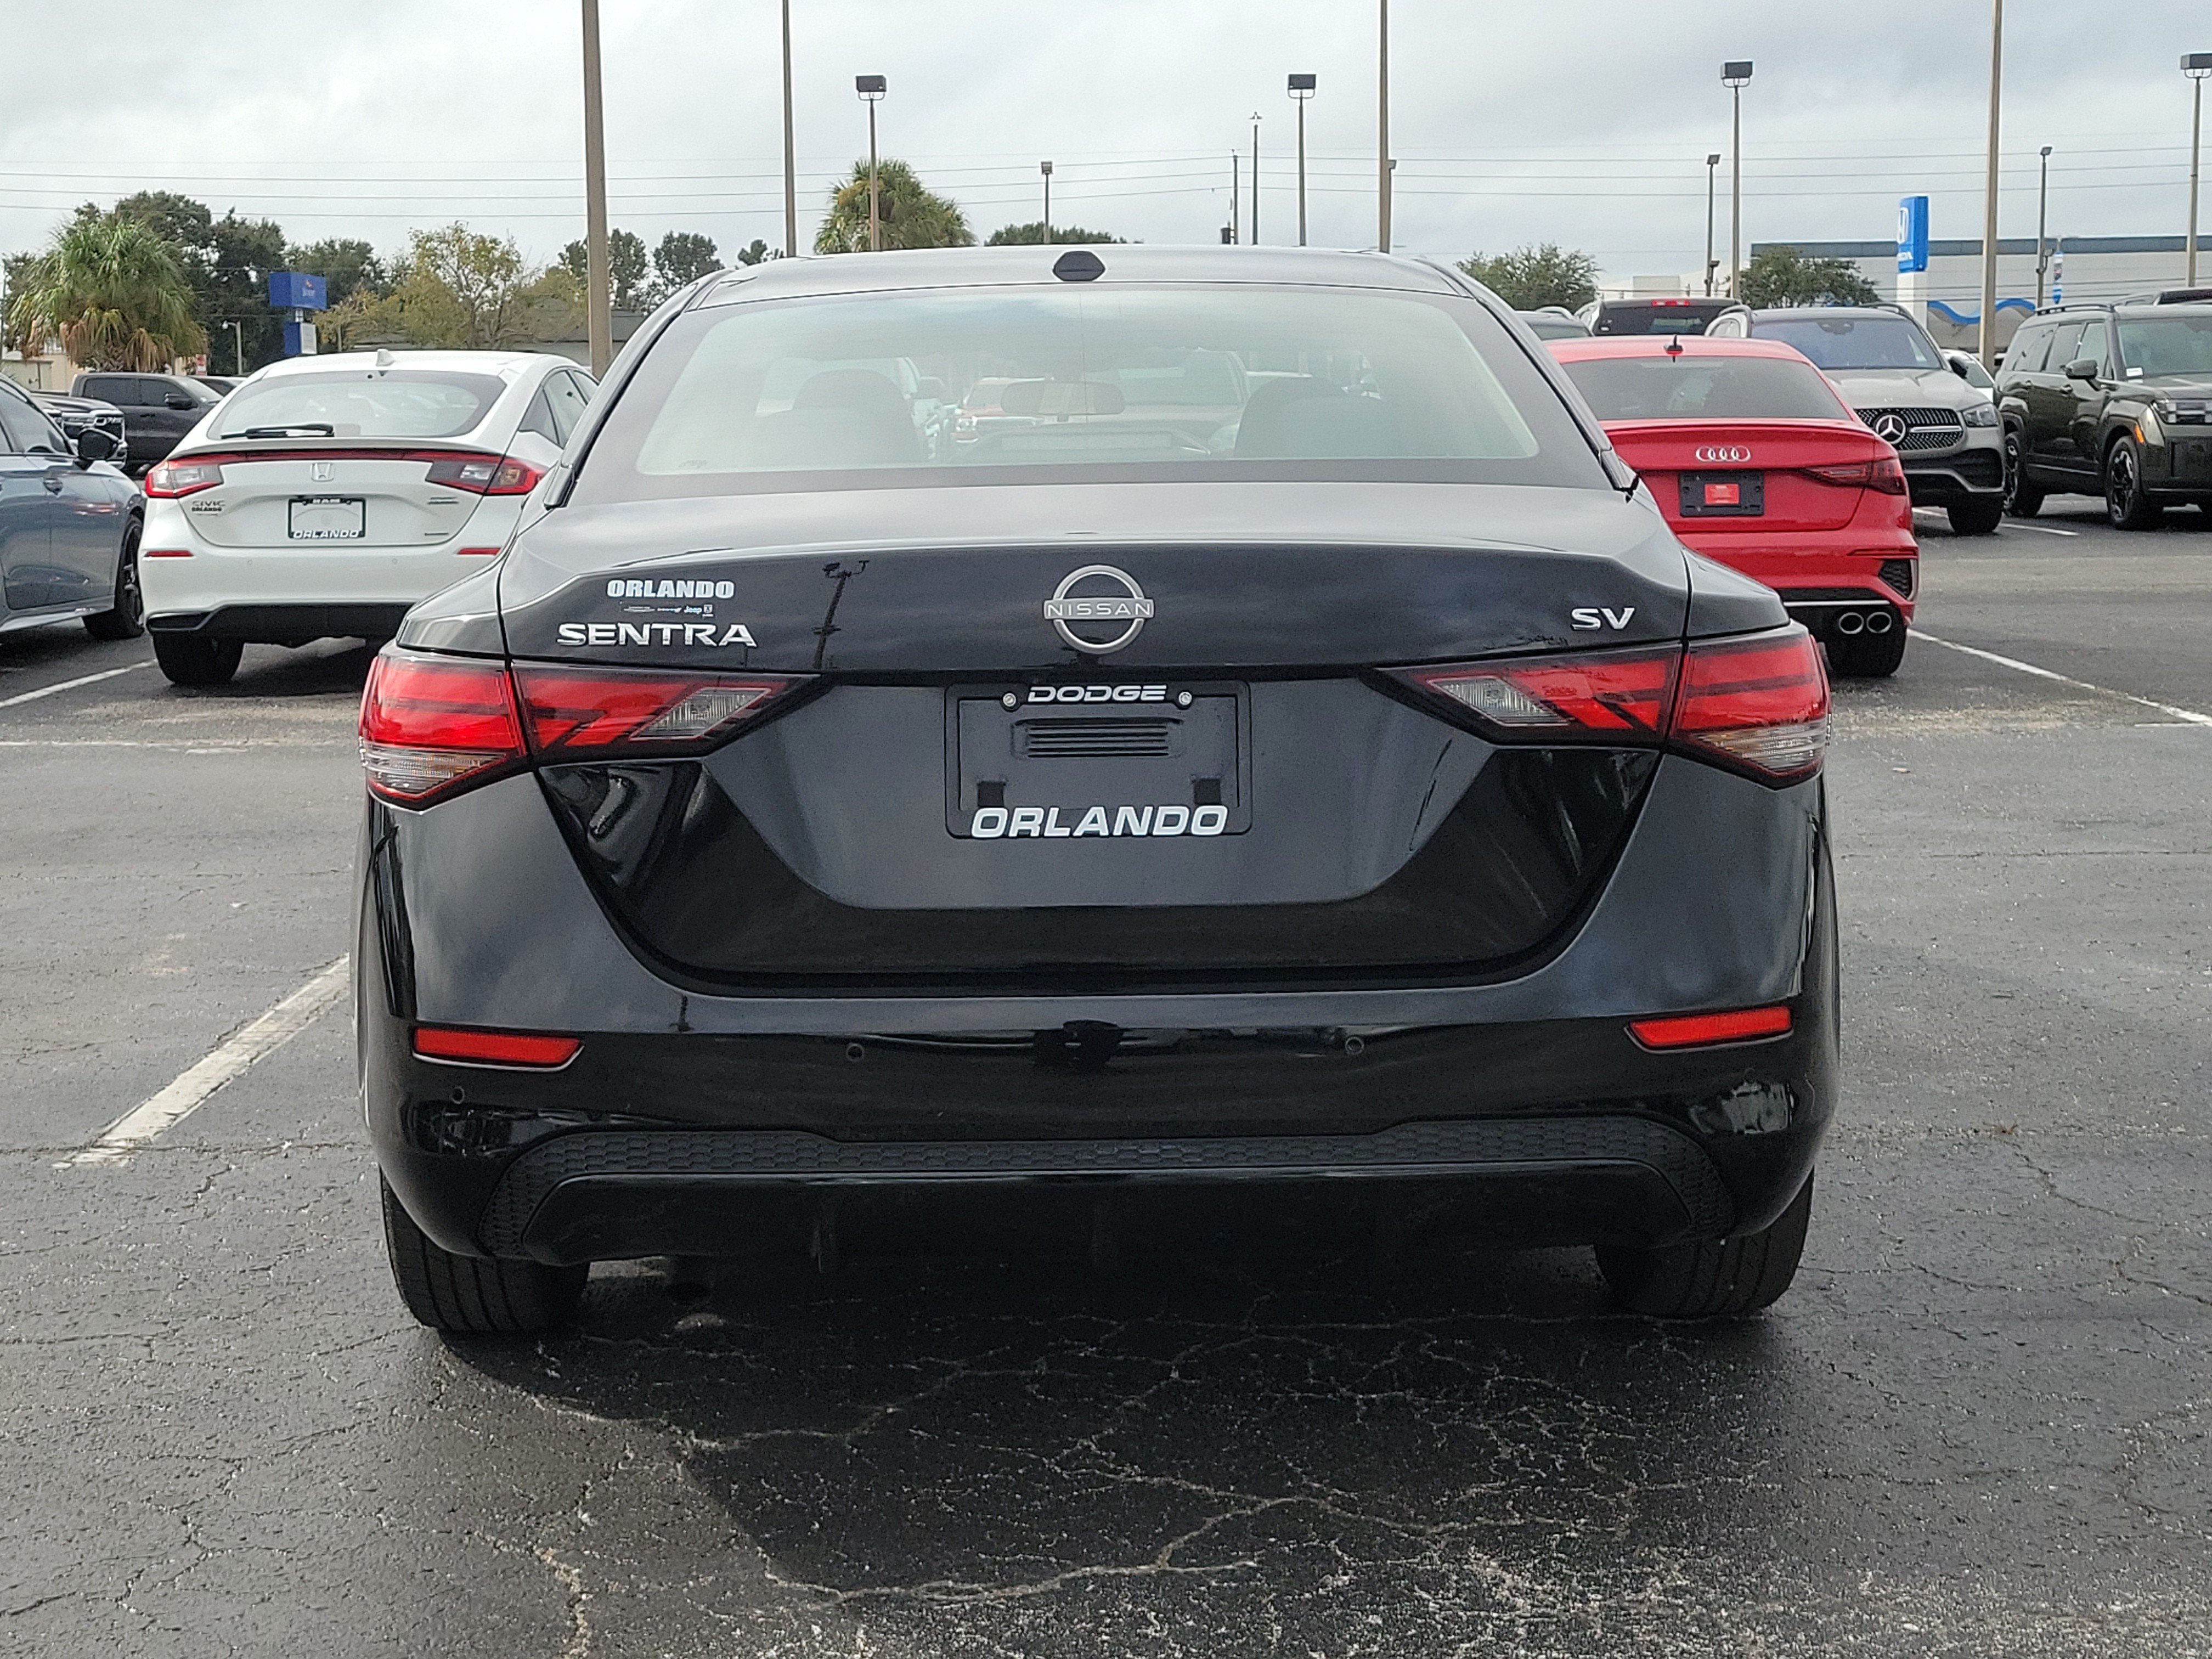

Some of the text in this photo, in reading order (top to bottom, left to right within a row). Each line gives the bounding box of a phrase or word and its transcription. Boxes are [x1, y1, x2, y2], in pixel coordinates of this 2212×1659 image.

[293, 529, 359, 539] ORLANDO
[607, 579, 735, 599] ORLANDO
[1047, 603, 1150, 617] NISSAN
[1571, 607, 1635, 630] SV
[557, 622, 758, 648] SENTRA
[1028, 684, 1167, 702] DODGE
[971, 805, 1228, 838] ORLANDO
